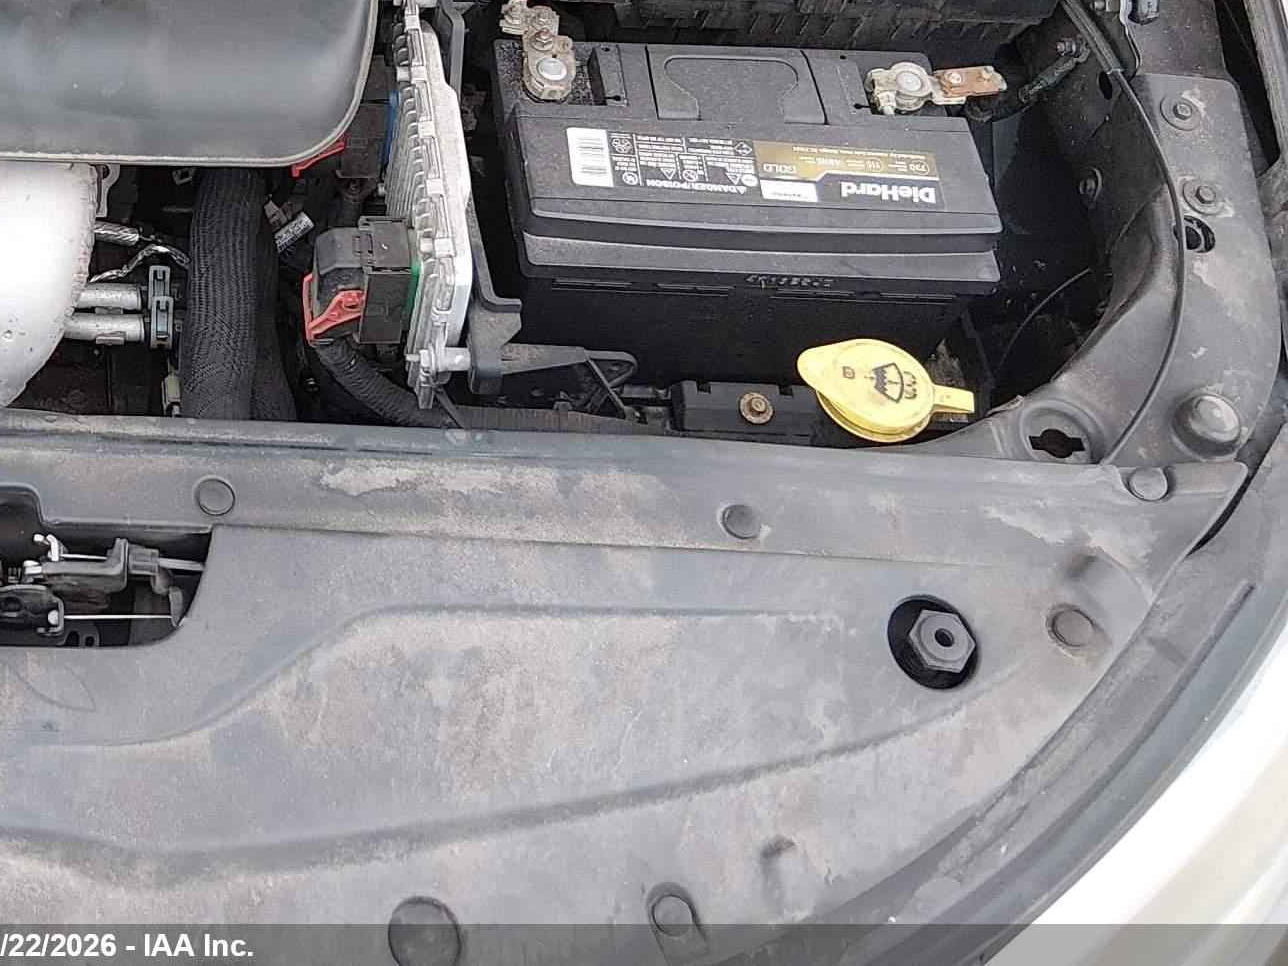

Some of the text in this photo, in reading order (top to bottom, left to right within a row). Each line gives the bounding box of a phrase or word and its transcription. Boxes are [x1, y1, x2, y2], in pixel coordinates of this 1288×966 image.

[763, 163, 797, 175] GOLD
[909, 163, 927, 172] 730
[840, 181, 937, 204] DieHard
